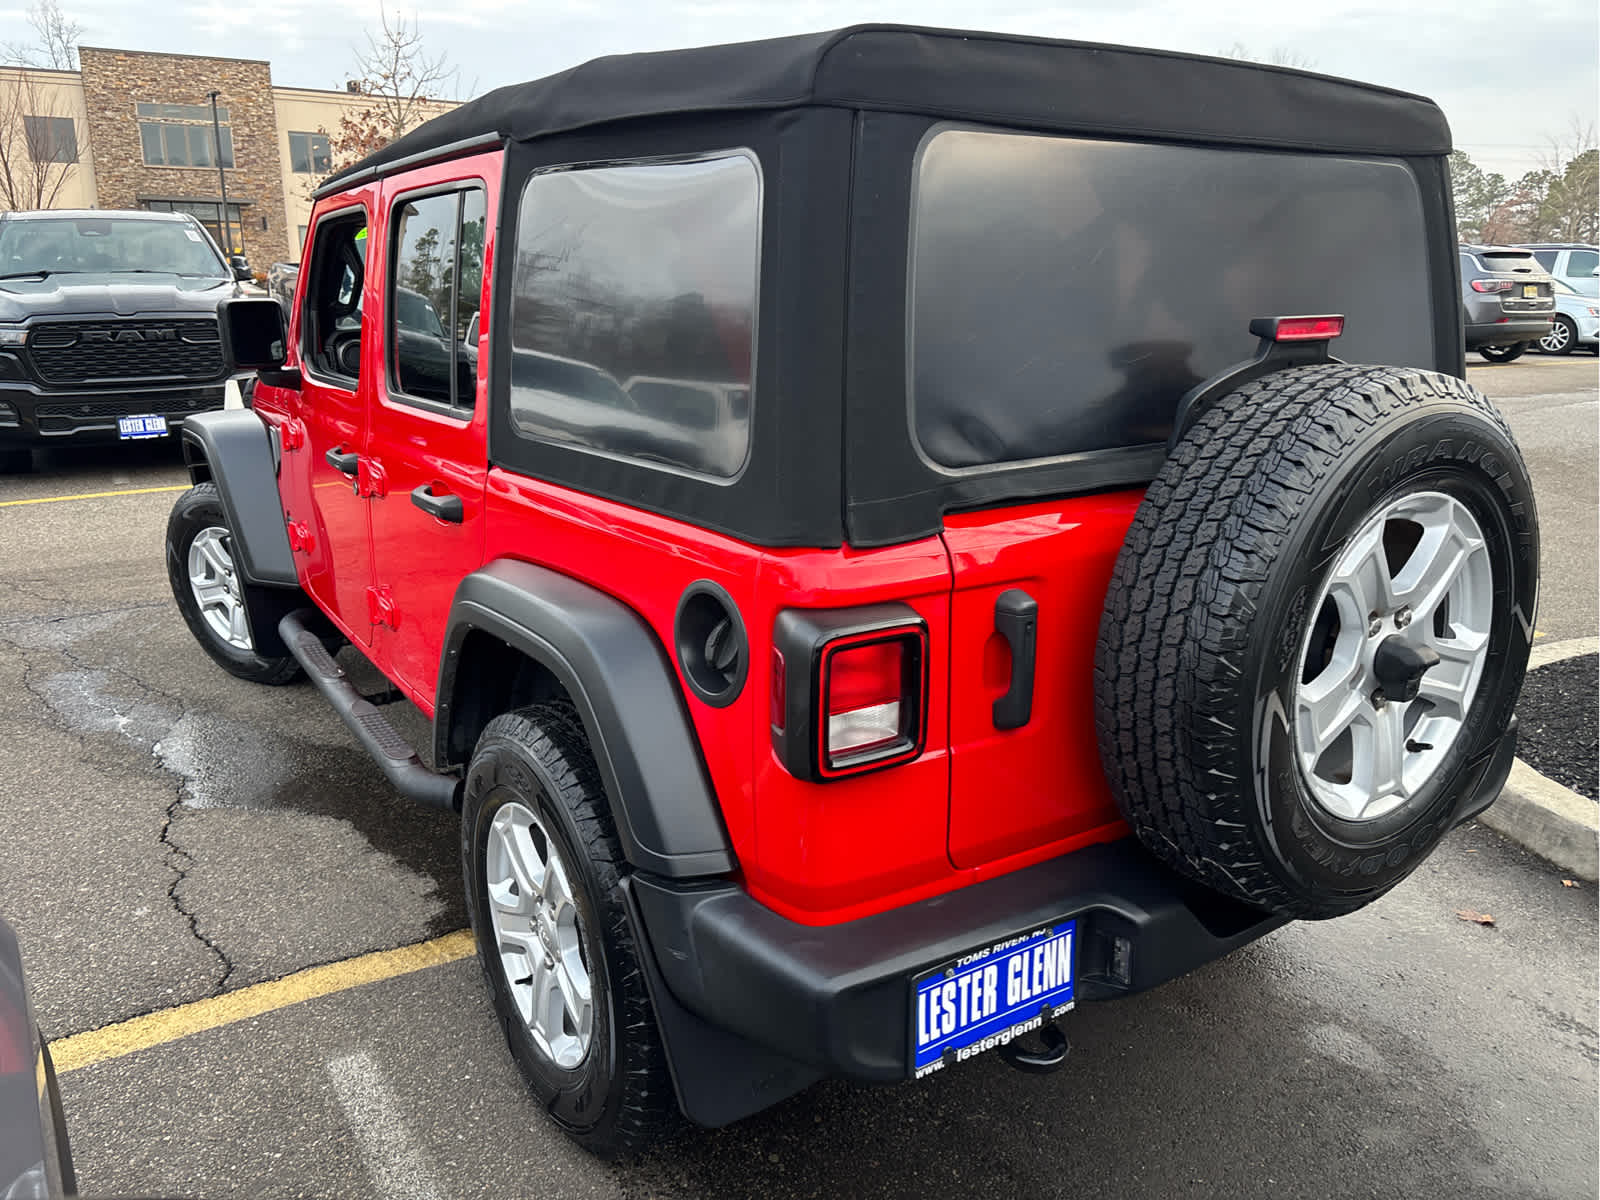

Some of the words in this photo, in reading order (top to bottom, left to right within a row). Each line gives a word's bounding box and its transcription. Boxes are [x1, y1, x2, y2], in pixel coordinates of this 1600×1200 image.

[79, 329, 177, 342] RAM
[956, 948, 990, 968] TOMS
[918, 964, 998, 1046] LESTER
[1006, 934, 1072, 1006] GLENN
